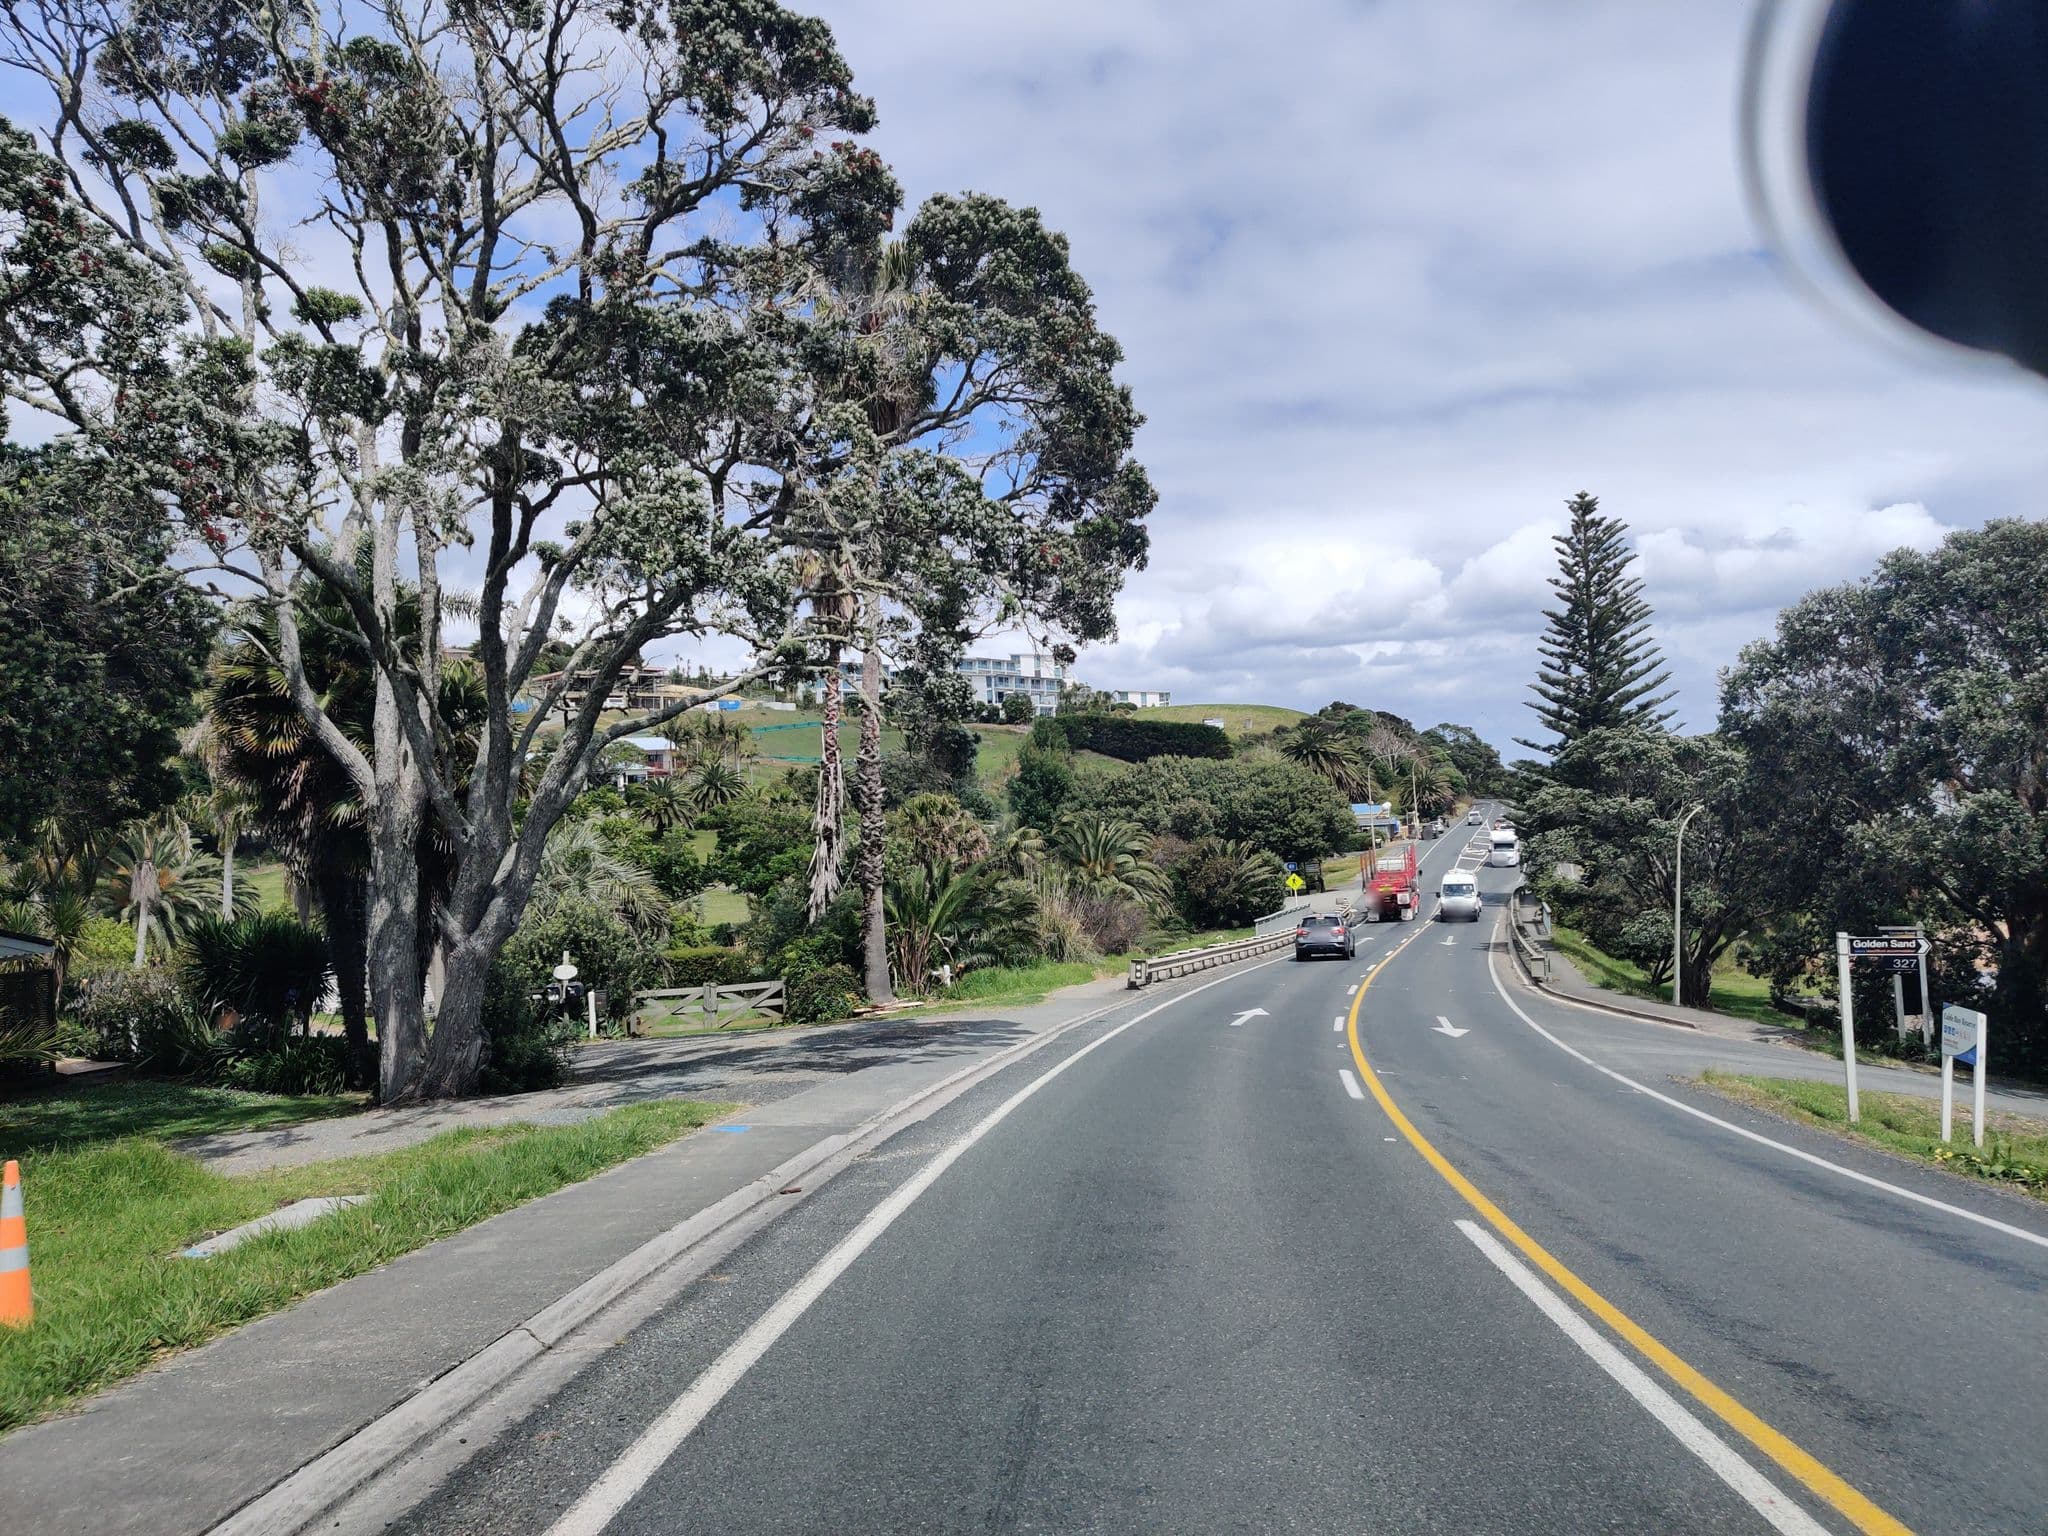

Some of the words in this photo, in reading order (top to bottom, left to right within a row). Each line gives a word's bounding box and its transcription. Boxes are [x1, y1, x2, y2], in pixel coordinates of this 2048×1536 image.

[1853, 940, 1888, 948] Golden
[1890, 940, 1916, 948] Sand
[1893, 959, 1917, 968] 327
